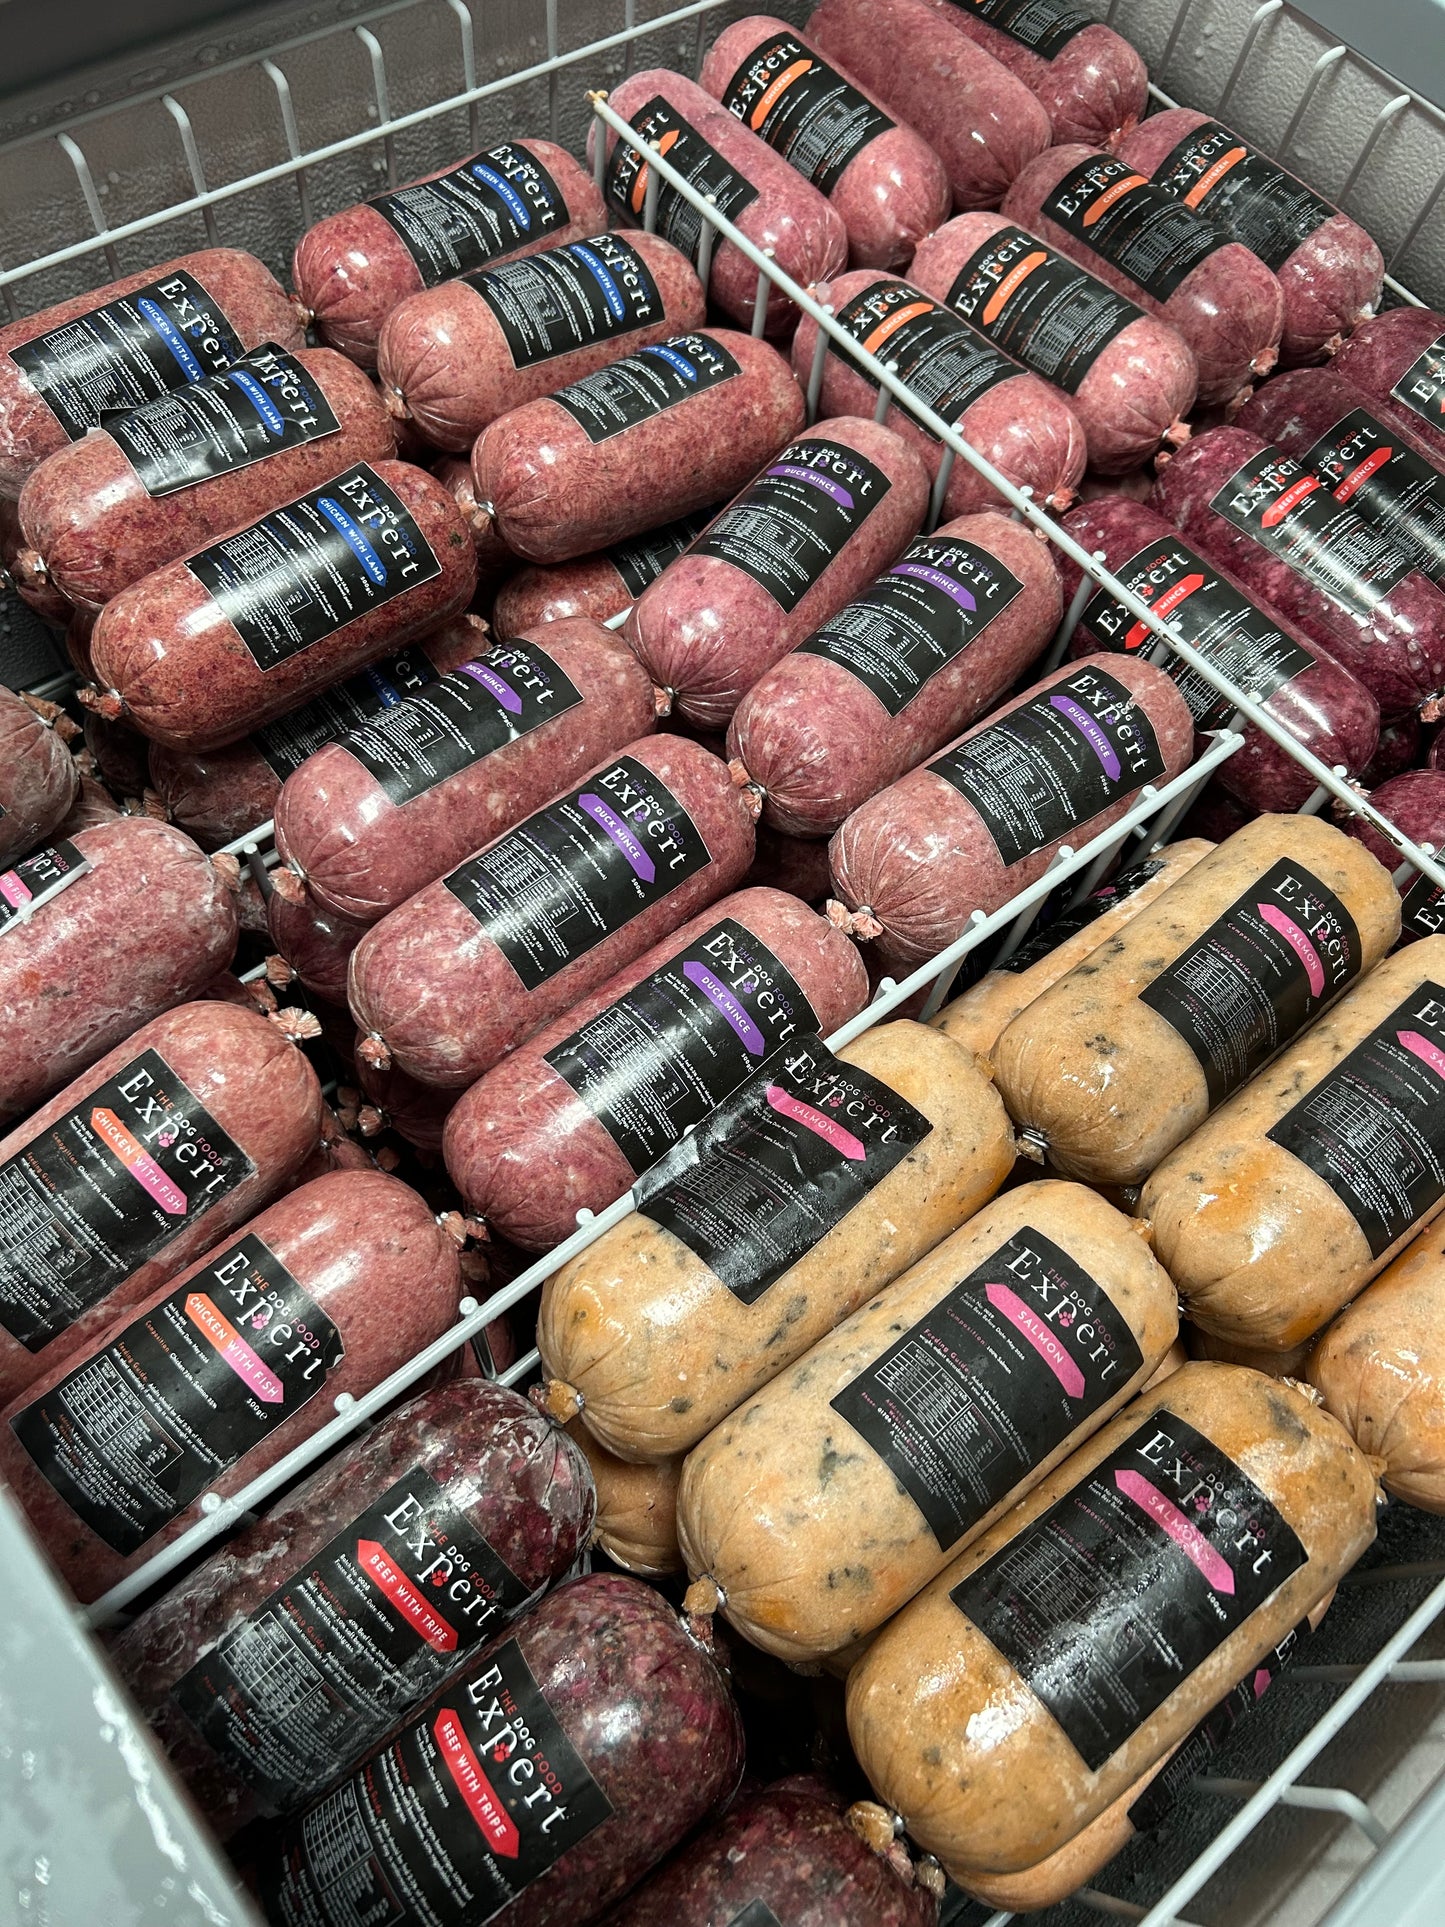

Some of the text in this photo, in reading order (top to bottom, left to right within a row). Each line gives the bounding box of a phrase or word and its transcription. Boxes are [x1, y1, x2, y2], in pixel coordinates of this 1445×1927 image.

[729, 43, 801, 120] Expert
[748, 60, 764, 76] DOG
[764, 73, 792, 105] CHICKEN
[475, 165, 528, 226] CHICKEN WITH LAMB
[488, 145, 556, 225] Expert
[524, 163, 539, 180] DOG
[1103, 181, 1132, 203] CHICKEN
[571, 245, 623, 317] CHICKEN WITH LAMB
[588, 235, 651, 319] Expert
[624, 256, 639, 273] DOG
[955, 236, 1032, 318] Expert
[979, 254, 994, 270] DOG
[1000, 265, 1028, 297] CHICKEN
[140, 300, 190, 362] CHICKEN WITH
[158, 279, 230, 370] Exper
[202, 312, 220, 334] DOG
[881, 309, 913, 334] CHICKEN
[286, 369, 300, 386] DOG
[250, 382, 282, 431] WITH LAMB
[776, 446, 873, 497] Expert
[784, 467, 837, 493] DUCK MINCE
[820, 449, 841, 460] DOG
[1259, 464, 1275, 477] DOG
[1318, 450, 1336, 468] DOG
[1350, 461, 1376, 485] MINCE
[381, 504, 400, 525] DOG
[1278, 480, 1312, 511] BEEF MINCE
[320, 498, 385, 583] CHICKEN WITH LAMB
[338, 475, 420, 578] Expert
[903, 543, 1001, 599] Expert
[948, 547, 968, 559] DOG
[1127, 554, 1168, 590] DOG FOOD
[907, 566, 959, 594] DUCK MINCE
[1159, 586, 1186, 610] MINCE
[512, 649, 530, 662] DOG
[482, 674, 506, 695] MINCE
[1067, 674, 1147, 773] Expert
[1067, 706, 1111, 758] DUCK MINCE
[599, 766, 687, 870] Expert
[645, 795, 665, 817] DOG
[593, 805, 641, 861] DUCK MINCE
[52, 854, 70, 872] FOOD
[1272, 874, 1348, 985] Expert
[1286, 926, 1318, 971] SALMON
[1307, 892, 1350, 961] THE DOG FOOD
[701, 976, 750, 1034] DUCK MINCE
[703, 931, 797, 1041] Expert
[753, 965, 773, 987] DOG
[773, 987, 793, 1016] FOOD
[788, 1050, 898, 1144] Expert
[791, 1105, 836, 1136] SALMON
[838, 1080, 891, 1118] DOG FOOD
[118, 1068, 229, 1194] Expert
[155, 1089, 223, 1167] THE DOG FOOD
[95, 1110, 184, 1210] CHICKEN WITH FISH
[100, 1192, 117, 1210] Salmon
[214, 1251, 323, 1381] Expert
[250, 1269, 320, 1350] THE DOG FOOD
[1005, 1246, 1119, 1381] Expert
[1047, 1267, 1117, 1351] THE DOG FOOD
[189, 1295, 279, 1398] CHICKEN WITH FISH
[922, 1326, 949, 1354] Feeding
[984, 1344, 1012, 1374] 100% Salmon
[1004, 1338, 1016, 1350] May
[1017, 1310, 1064, 1365] SALMON
[168, 1351, 209, 1399] Chicken Salmon
[1181, 1450, 1204, 1472] THE
[384, 1492, 501, 1628] Expert
[427, 1520, 496, 1601] THE DOG FOOD
[279, 1594, 311, 1627] Feeding
[332, 1558, 387, 1622] Frozen Best Before FEB
[370, 1554, 449, 1643] BEEF WITH TRIPE
[356, 1627, 370, 1641] Beef
[467, 1663, 569, 1835] Expert
[500, 1688, 564, 1796] THE DOG FOOD
[441, 1721, 507, 1839] BEEF WITH TRIPE
